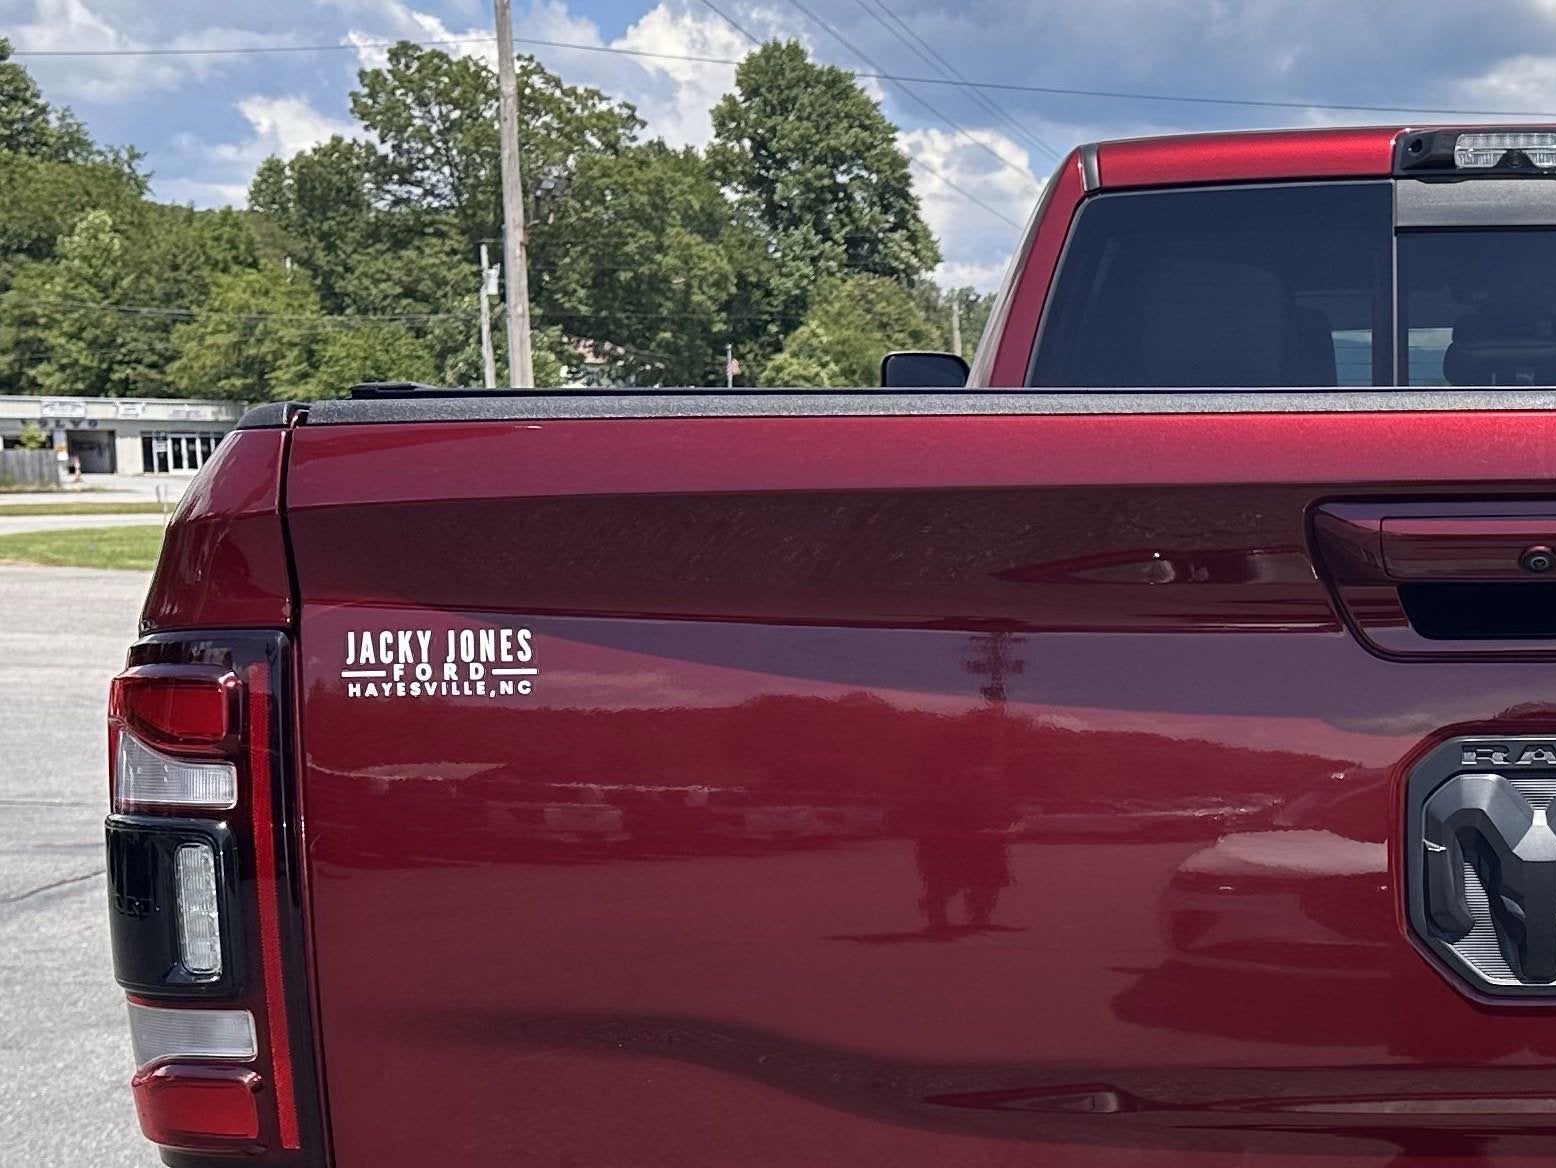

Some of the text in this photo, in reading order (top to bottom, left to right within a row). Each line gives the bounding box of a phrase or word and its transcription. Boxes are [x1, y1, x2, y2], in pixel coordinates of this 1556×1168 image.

[346, 629, 532, 665] JACKY JONES
[393, 662, 485, 682] FORD
